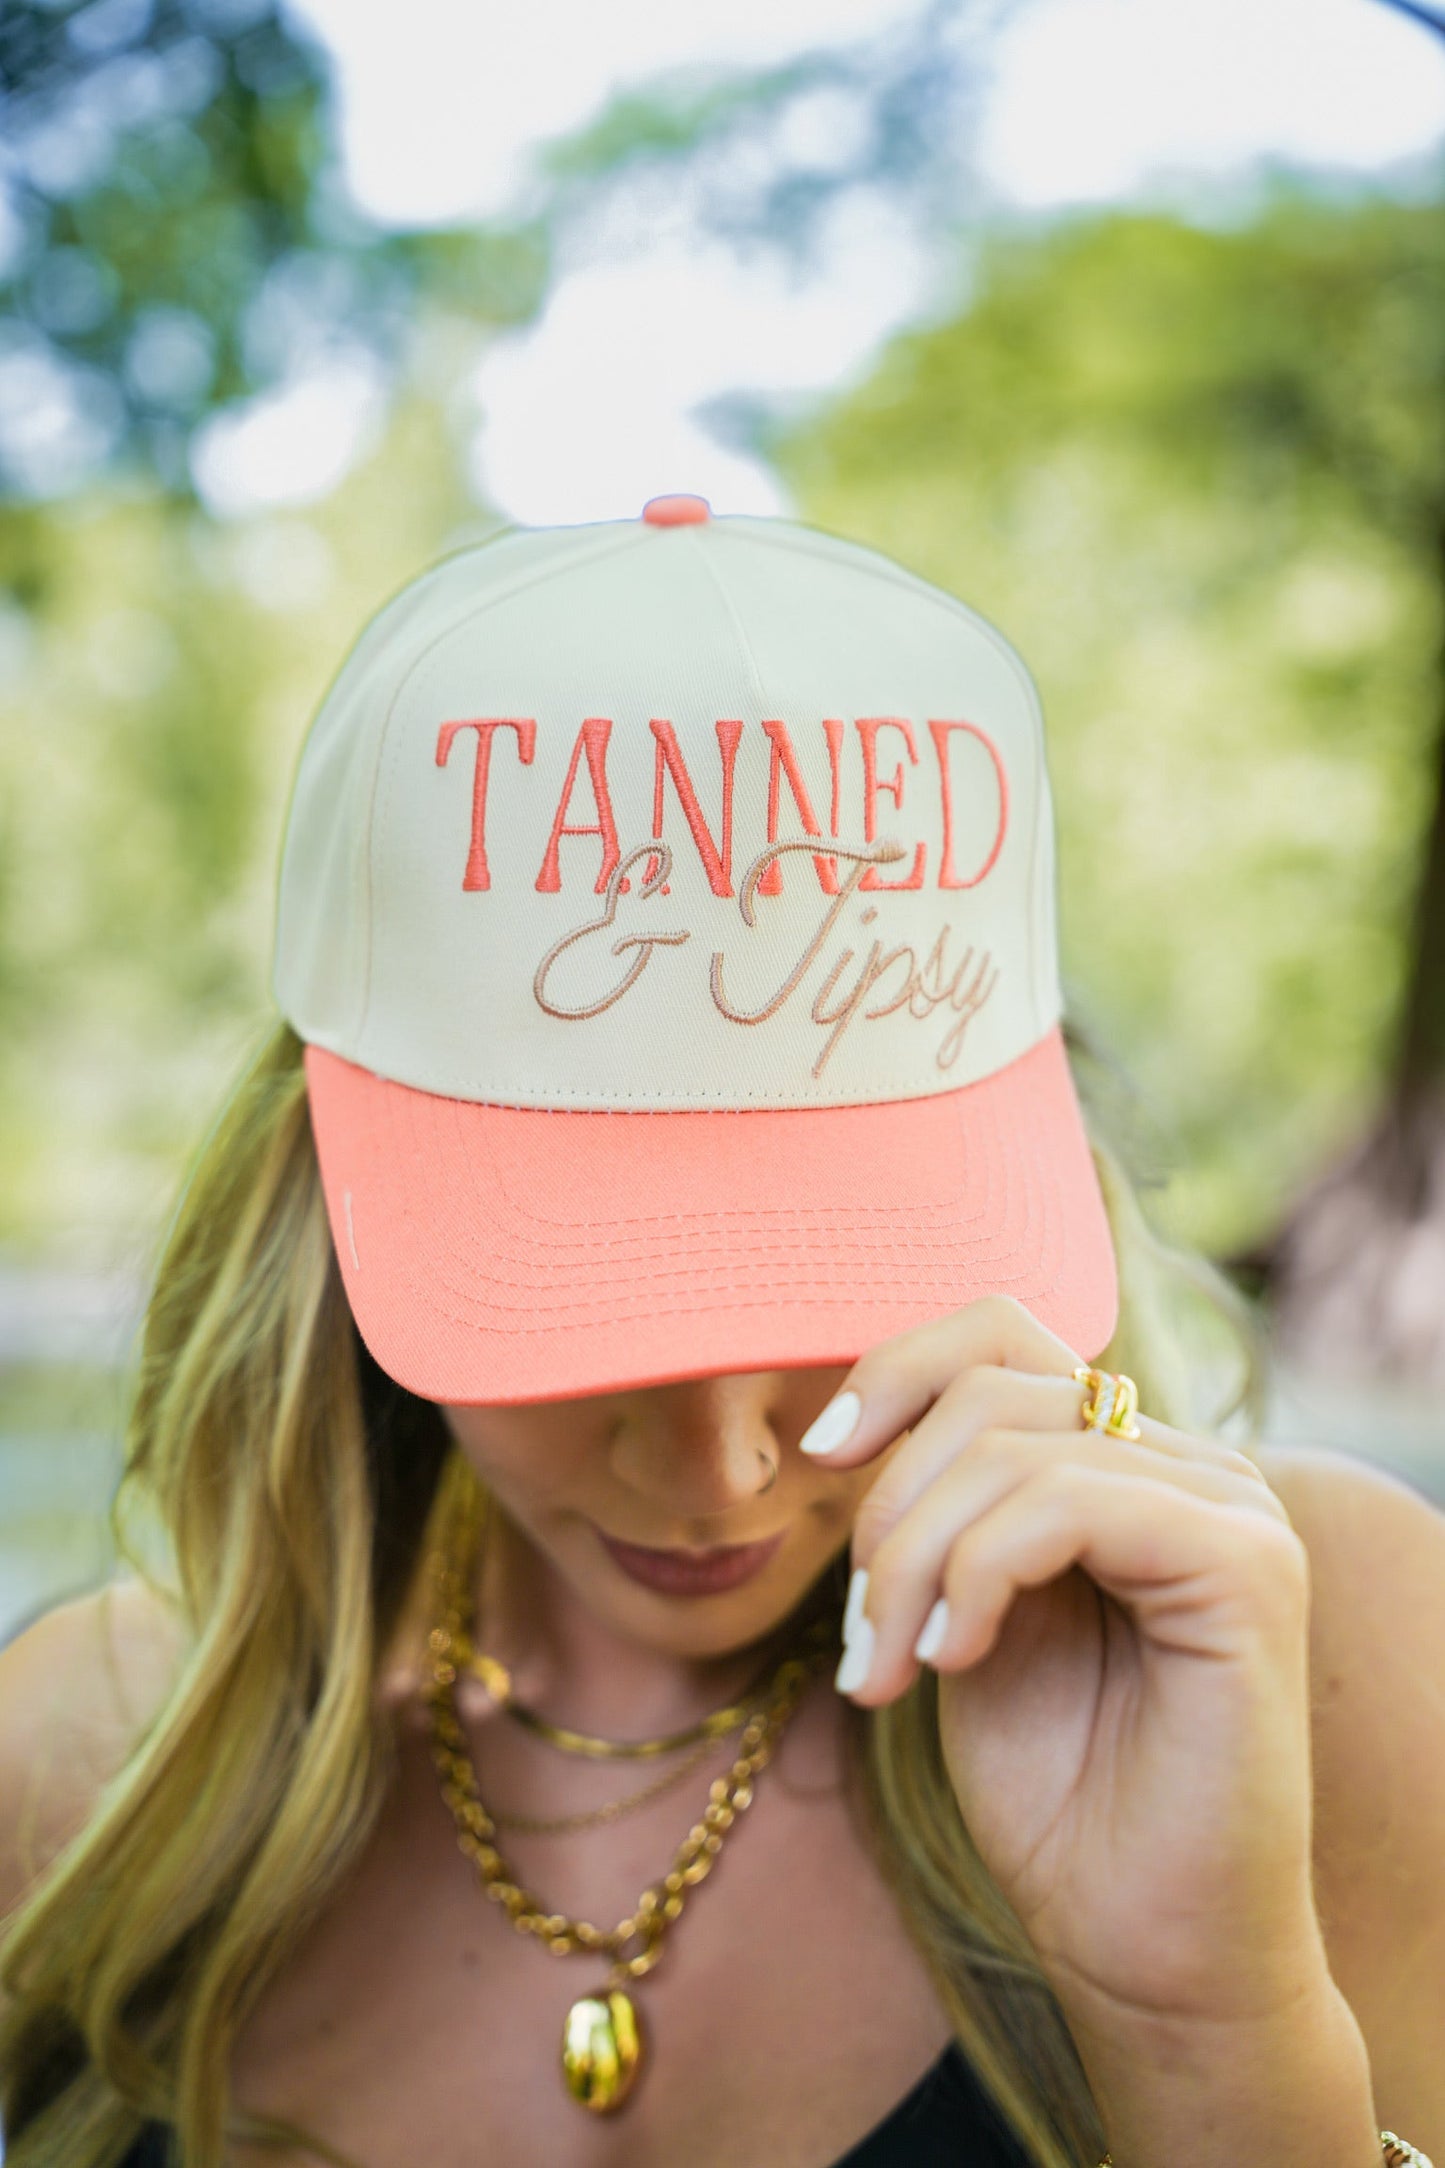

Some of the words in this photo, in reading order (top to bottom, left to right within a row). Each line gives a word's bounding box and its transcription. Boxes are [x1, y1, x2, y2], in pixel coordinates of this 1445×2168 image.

[435, 718, 1010, 897] TANNED
[533, 842, 691, 1020] &
[710, 836, 1001, 1079] Tipsy
